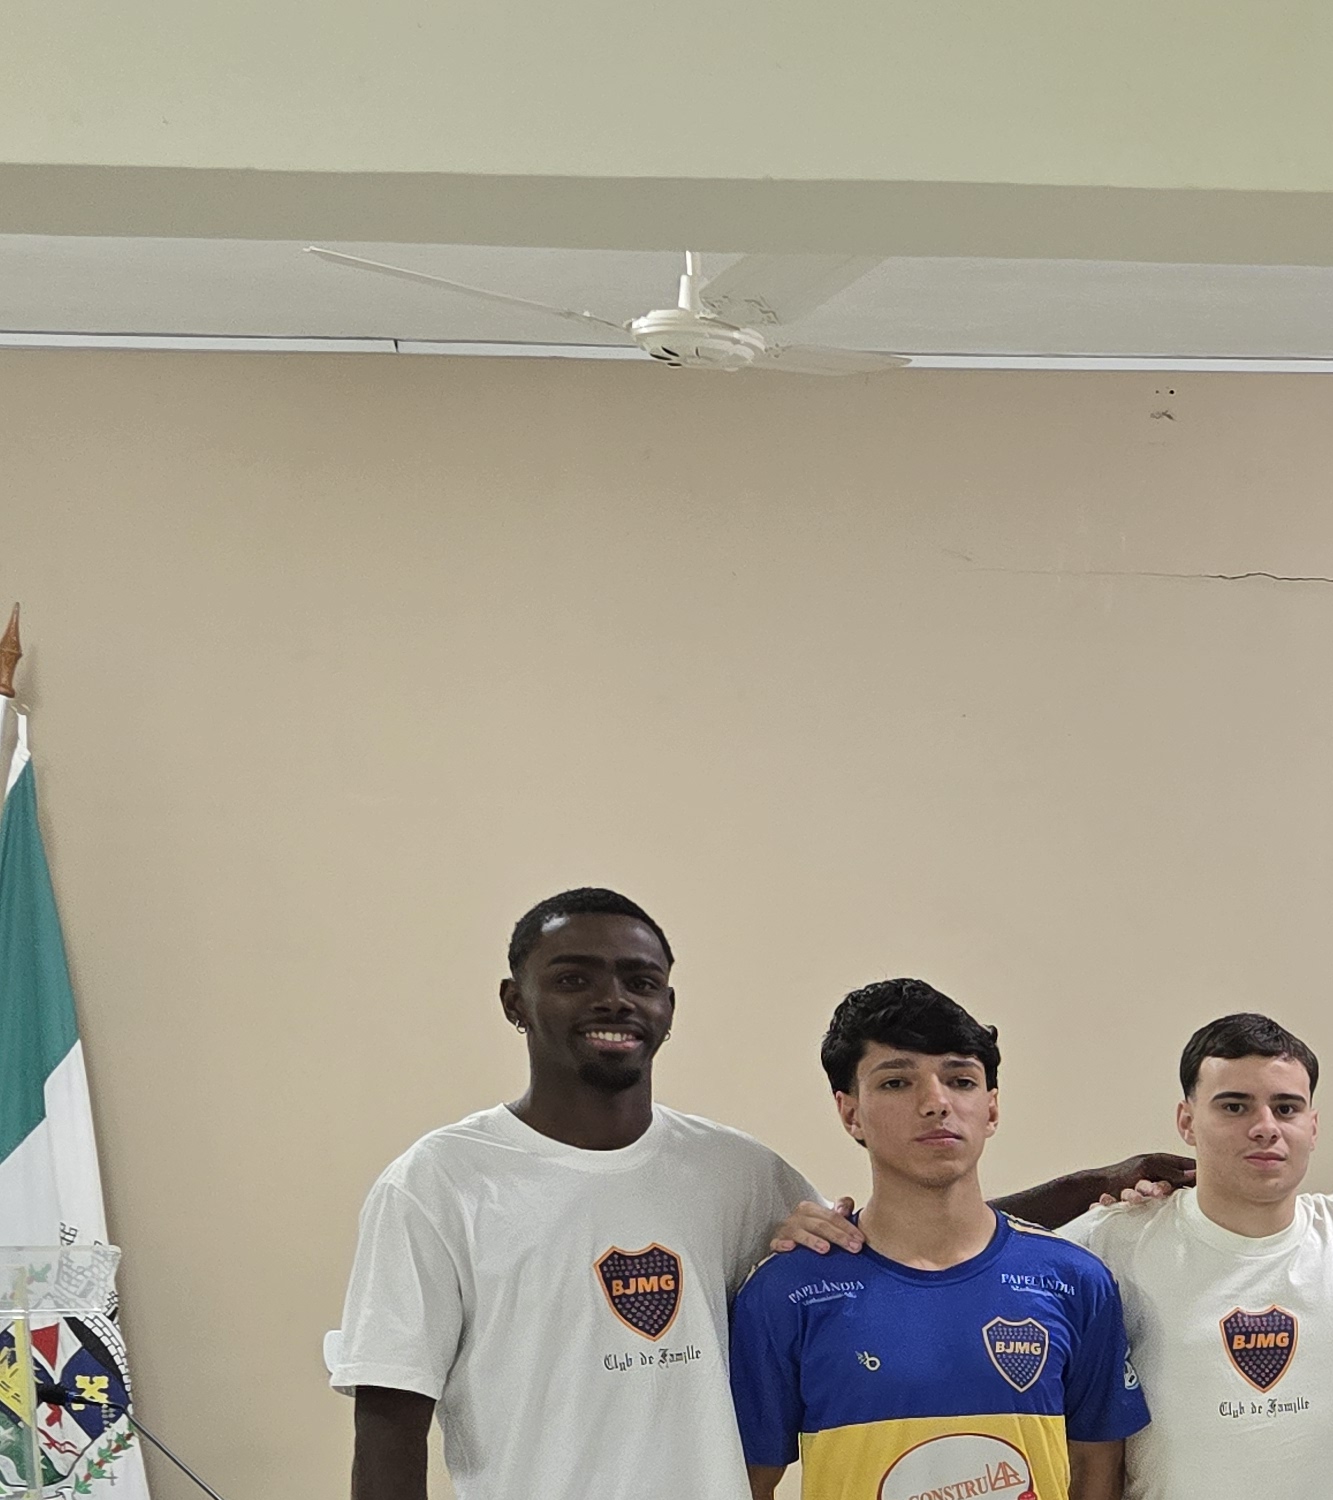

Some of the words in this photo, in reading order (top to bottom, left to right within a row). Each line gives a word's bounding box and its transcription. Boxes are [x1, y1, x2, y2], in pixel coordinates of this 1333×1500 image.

[611, 1274, 675, 1297] BJMG
[995, 1341, 1042, 1356] BJMG
[1232, 1332, 1290, 1350] BJMG
[639, 1351, 655, 1366] de
[1251, 1402, 1263, 1414] de
